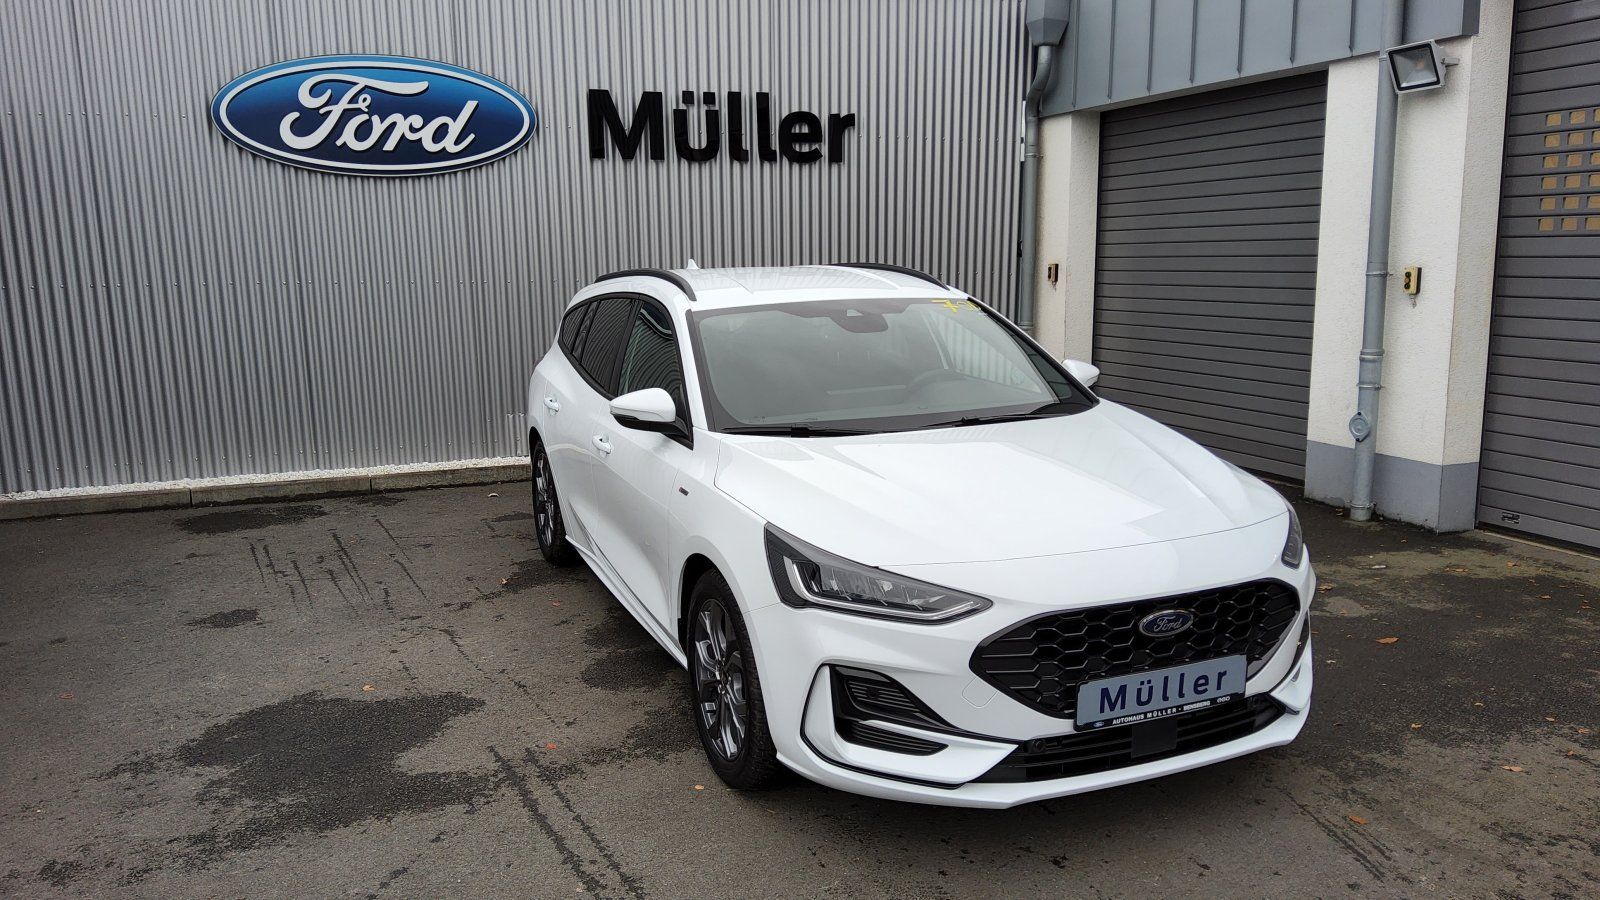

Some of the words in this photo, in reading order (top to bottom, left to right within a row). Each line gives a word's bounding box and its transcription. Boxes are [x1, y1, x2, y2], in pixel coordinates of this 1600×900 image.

[278, 73, 479, 153] Ford
[587, 88, 856, 163] Müller
[1153, 615, 1183, 632] Ford
[1099, 669, 1228, 714] Müller
[1112, 713, 1145, 725] AUTOHAUS
[1146, 707, 1177, 719] MÜLLER
